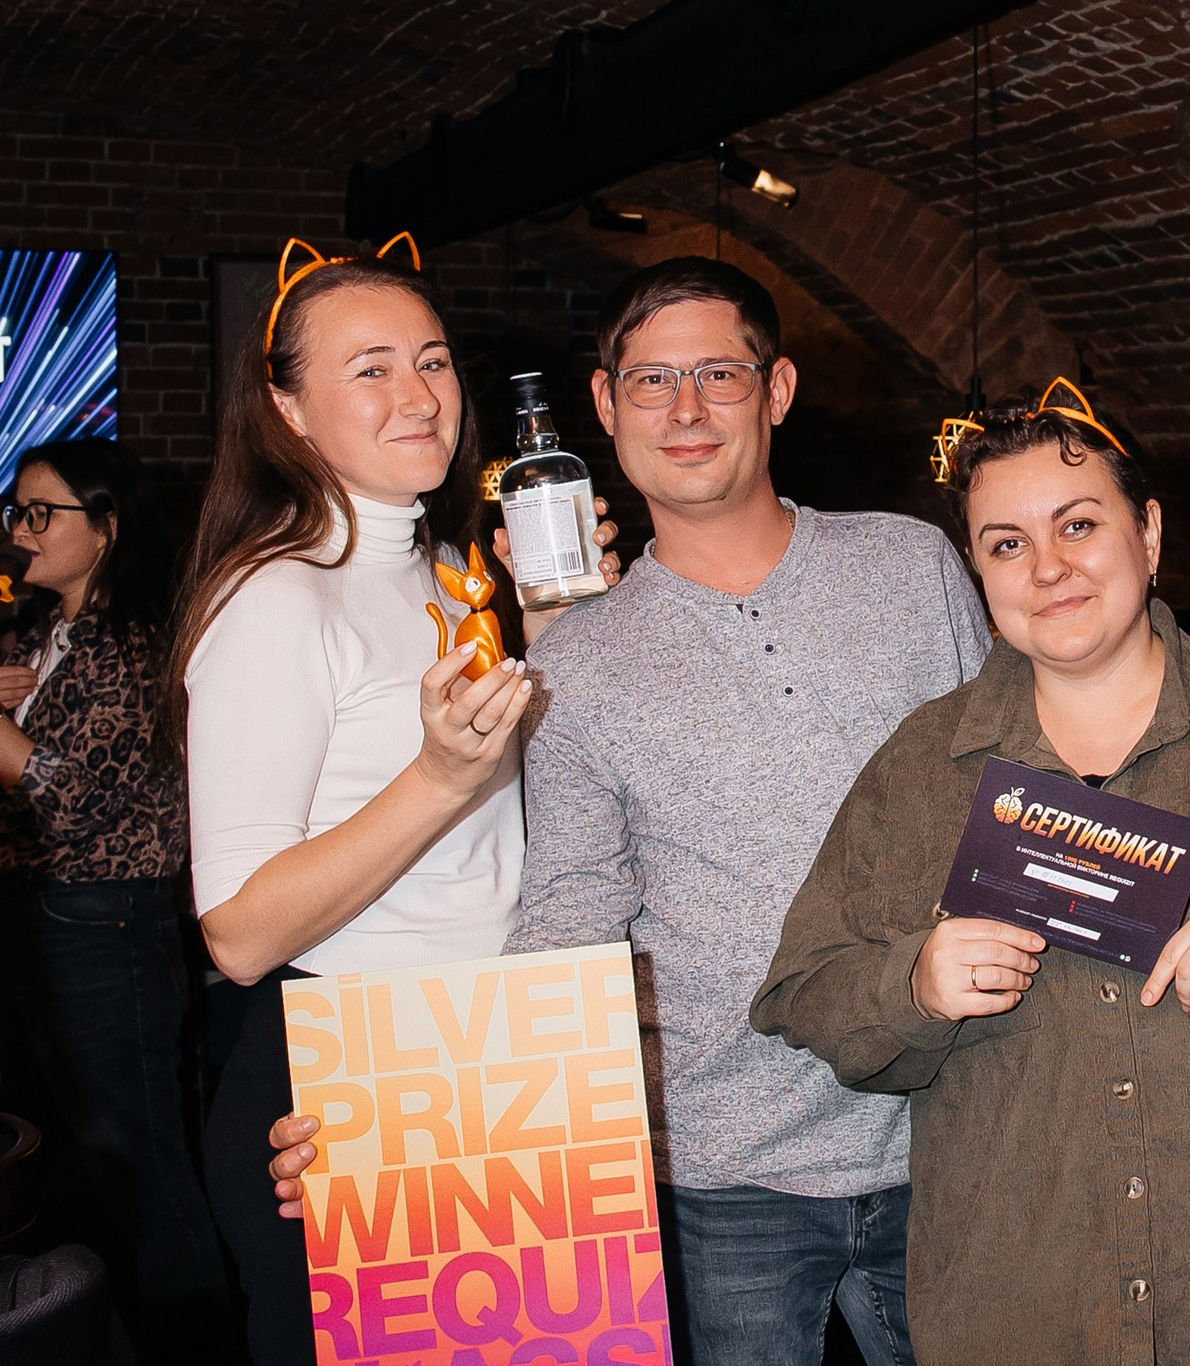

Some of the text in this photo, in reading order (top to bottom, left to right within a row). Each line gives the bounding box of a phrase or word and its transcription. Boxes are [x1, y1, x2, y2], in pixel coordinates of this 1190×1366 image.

[1020, 802, 1187, 875] СЕРТИФИКАТ
[298, 1048, 643, 1175] PRIZE
[303, 1139, 657, 1269] WINNE
